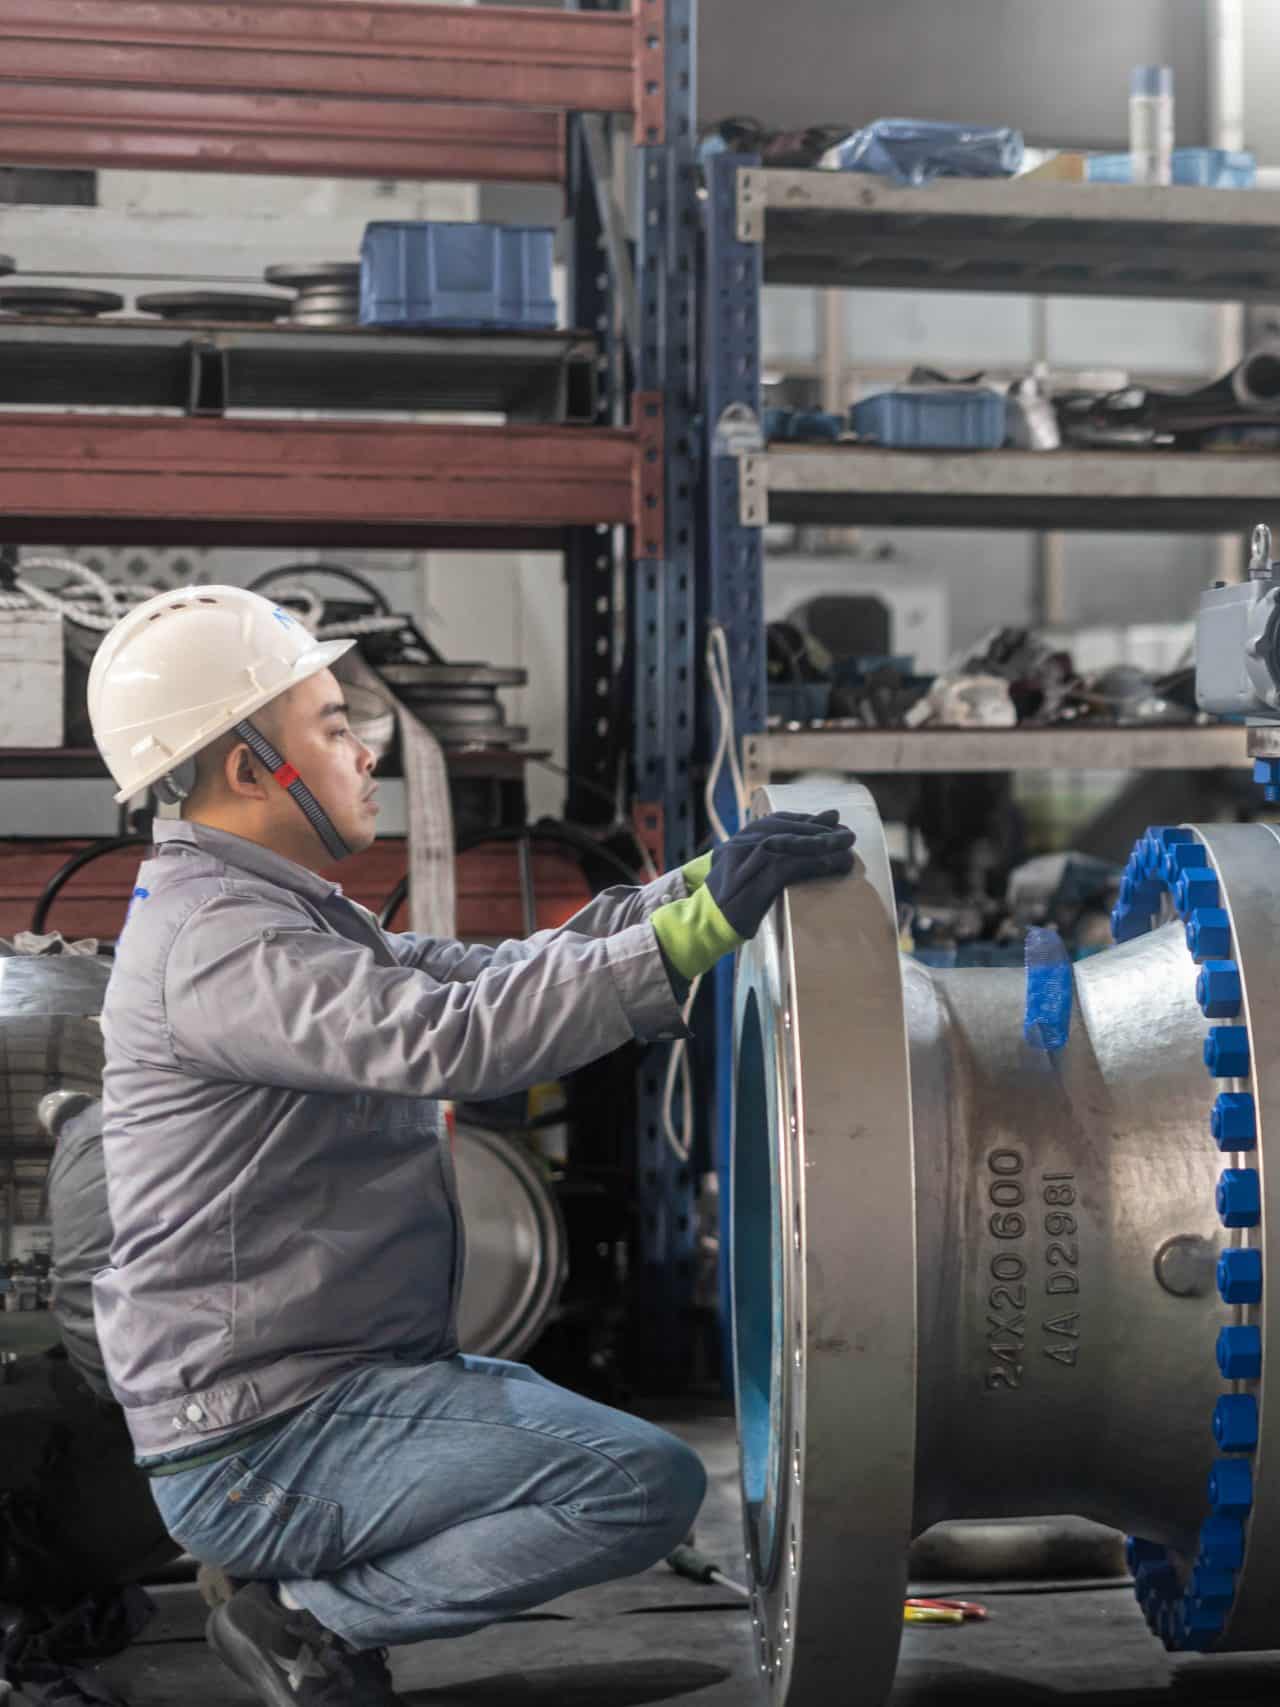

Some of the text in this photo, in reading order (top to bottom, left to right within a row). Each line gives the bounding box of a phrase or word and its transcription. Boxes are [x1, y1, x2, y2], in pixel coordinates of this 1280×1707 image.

[985, 1148, 1026, 1390] 24X20 600
[1041, 1172, 1081, 1367] 4A D2981
